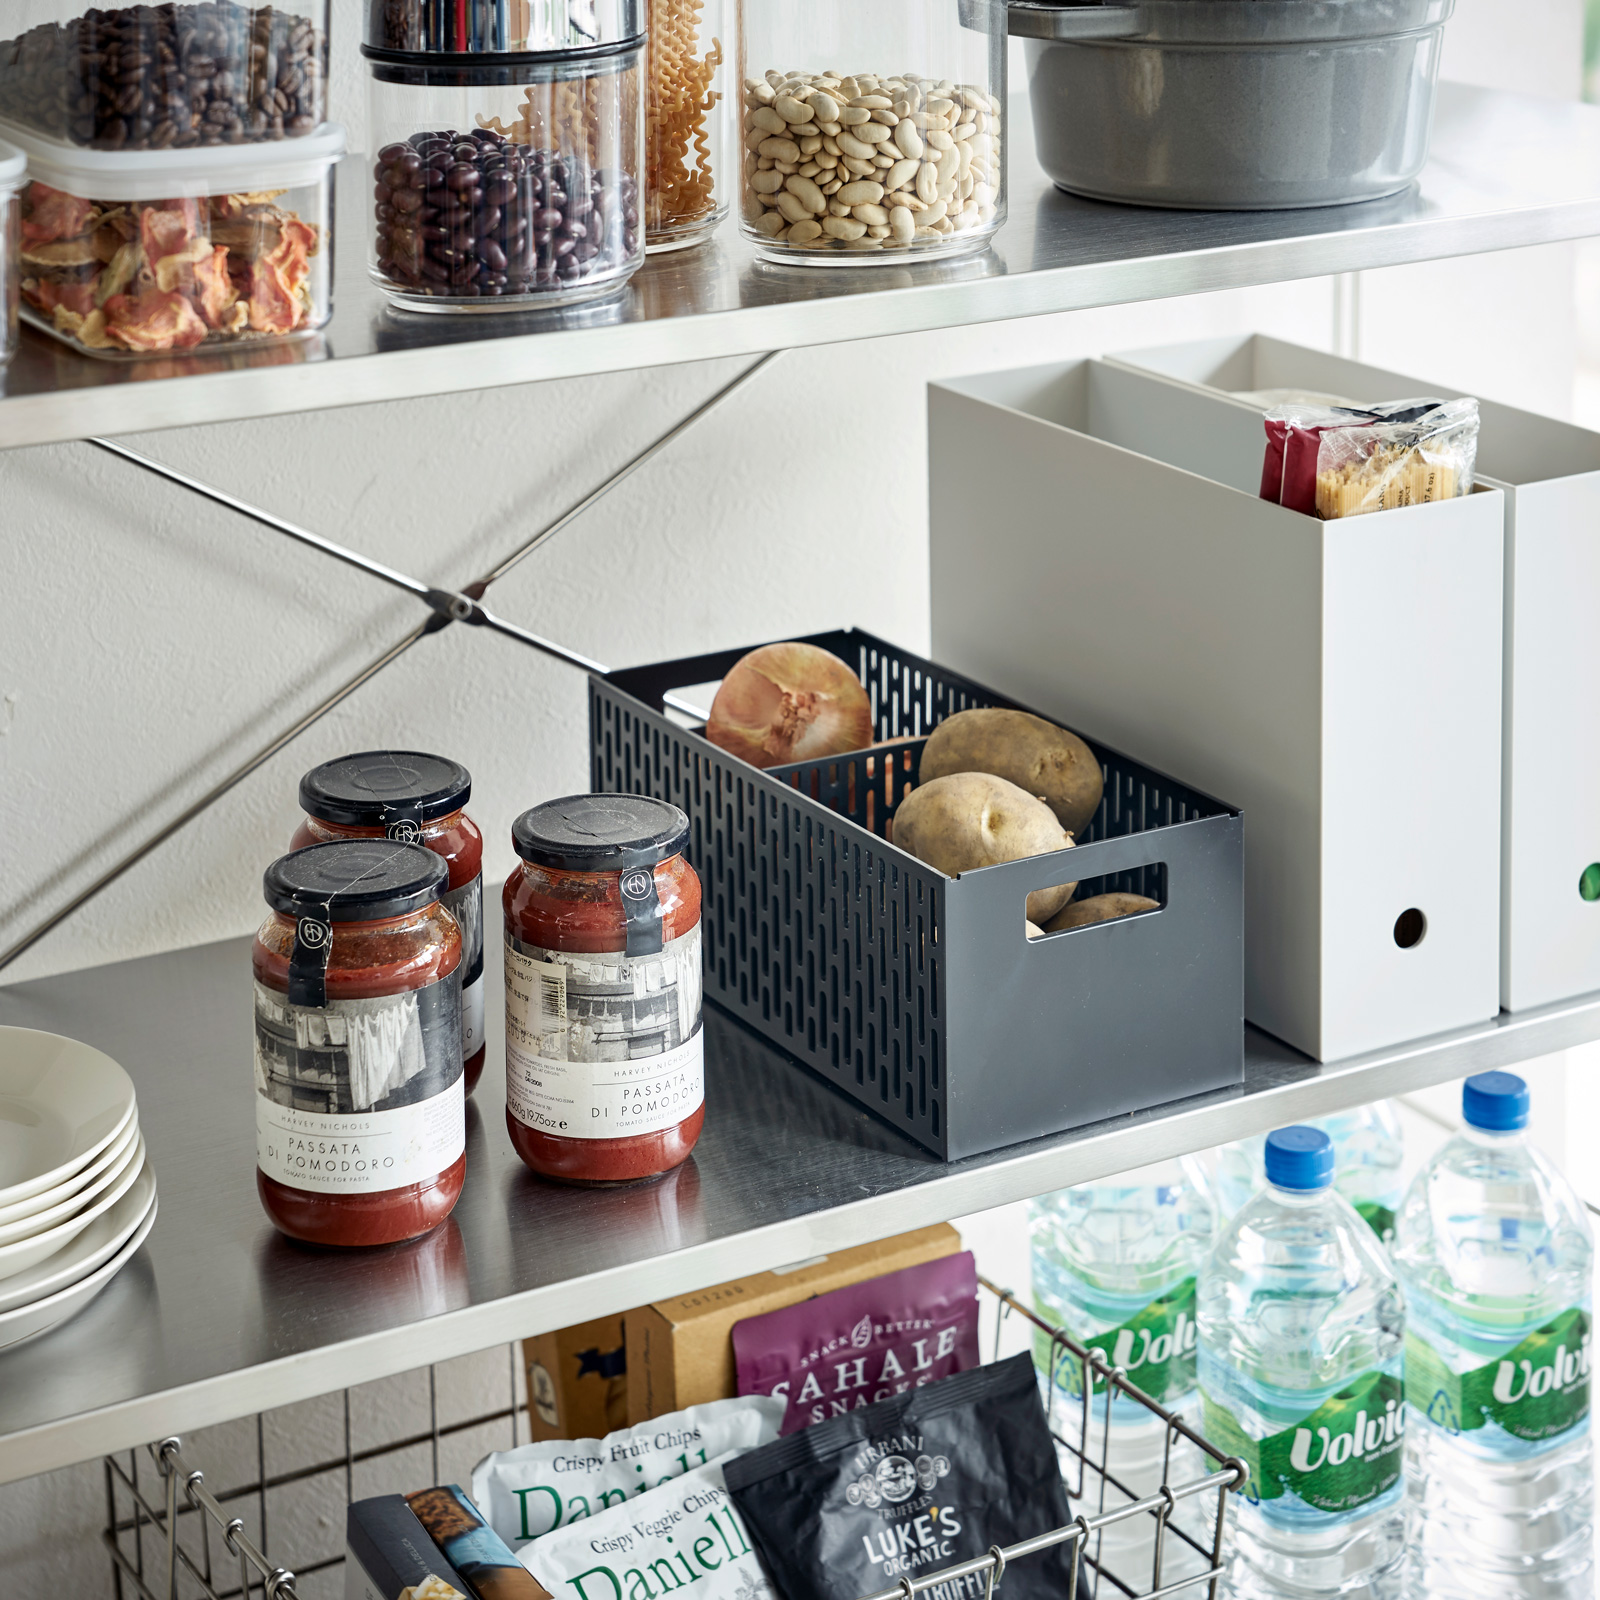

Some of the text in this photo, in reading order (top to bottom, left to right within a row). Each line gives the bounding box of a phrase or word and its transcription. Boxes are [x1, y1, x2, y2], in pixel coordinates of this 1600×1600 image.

[614, 1050, 690, 1077] HARVEY NICHOLS
[591, 1077, 700, 1118] DI POMODORO
[624, 1073, 685, 1100] PASSATA
[281, 1115, 370, 1131] HARVEY NICHOLS
[616, 1119, 643, 1127] TOMATO
[646, 1113, 665, 1122] SAUCE
[268, 1145, 279, 1160] DI
[287, 1154, 394, 1172] POMODORO
[289, 1137, 361, 1154] PASSATA
[283, 1168, 306, 1179] TOMATO
[309, 1174, 330, 1182] SAUCE
[800, 1319, 932, 1368] SNACK BETTER
[771, 1326, 958, 1405] SAHALE
[553, 1428, 702, 1474] Crispy Fruit Chips
[854, 1435, 924, 1469] URBANI
[590, 1484, 729, 1555] Crispy Veggie Chips
[876, 1493, 934, 1520] TRUFFLES
[565, 1504, 752, 1600] Daniell
[862, 1506, 962, 1564] LUKE'S
[883, 1540, 953, 1577] ORGANIC
